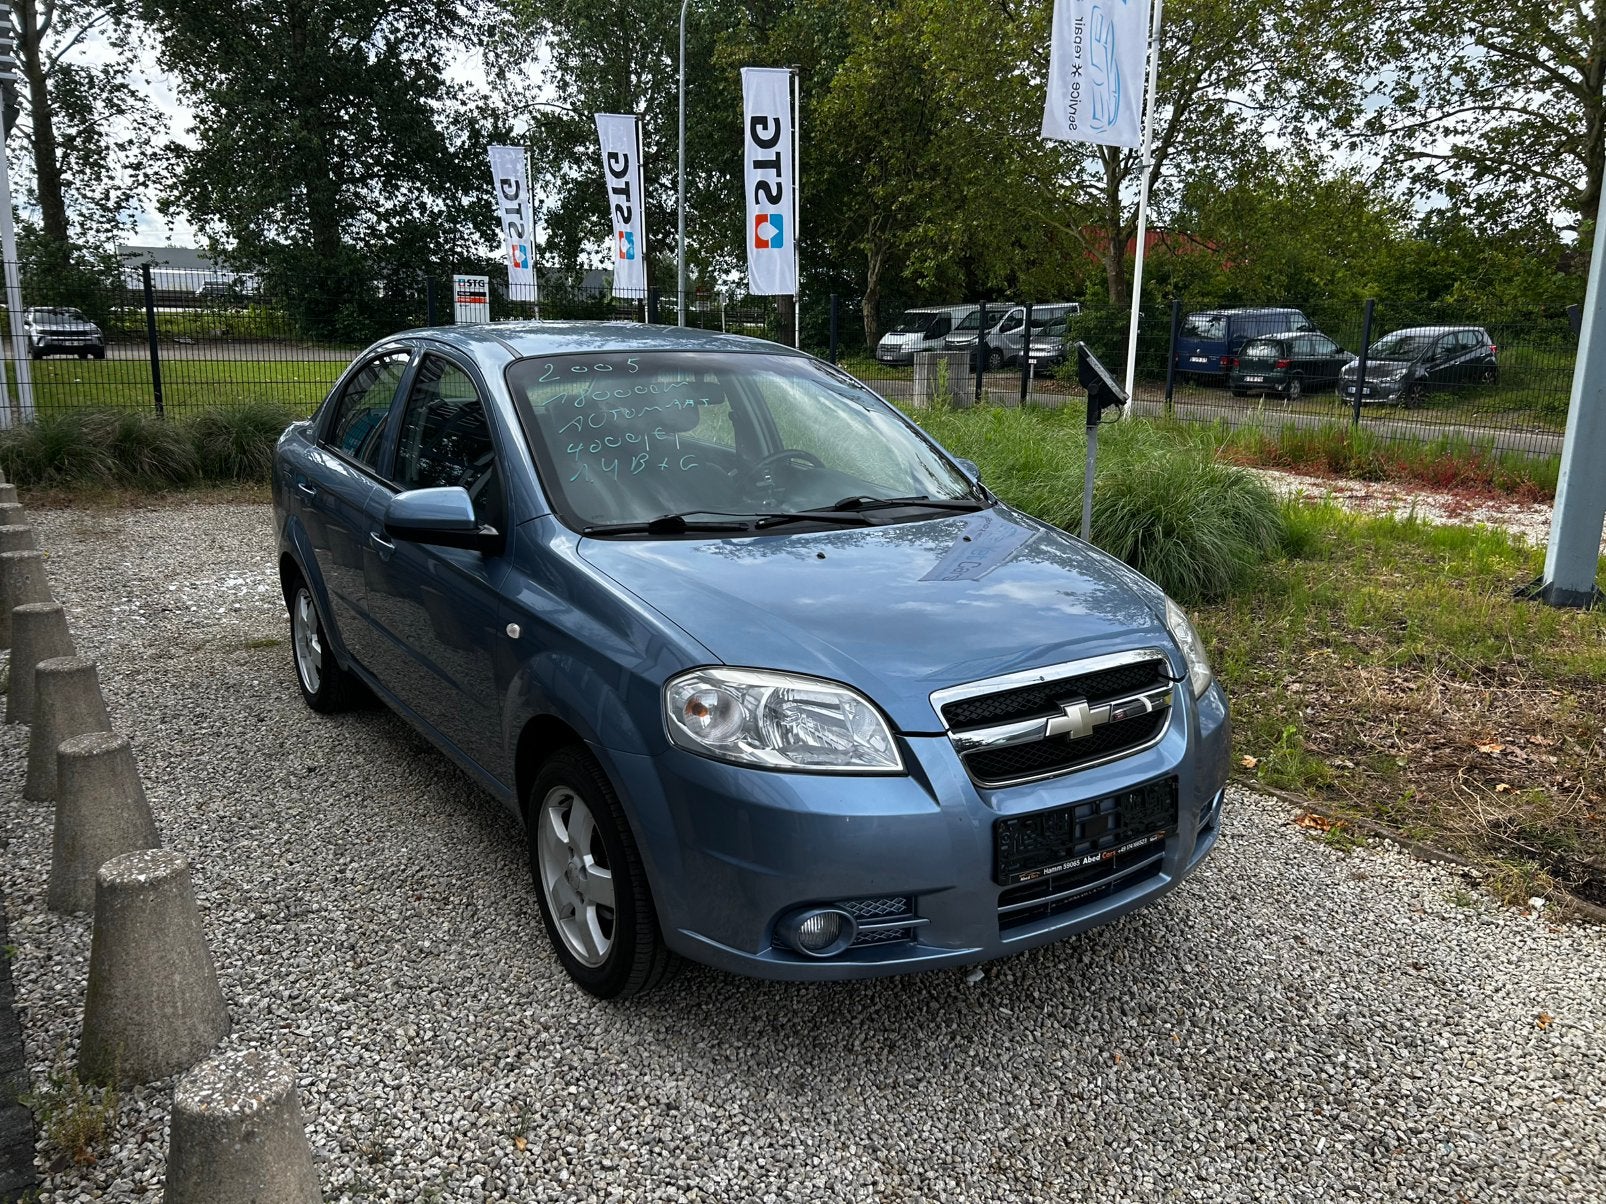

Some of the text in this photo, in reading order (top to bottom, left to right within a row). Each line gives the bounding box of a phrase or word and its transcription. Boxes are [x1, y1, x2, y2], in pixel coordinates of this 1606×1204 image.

[466, 278, 485, 288] STG
[538, 357, 640, 383] 2005
[1043, 865, 1063, 875] Hamm
[1082, 852, 1101, 865] Abed
[1101, 850, 1116, 859] Cars
